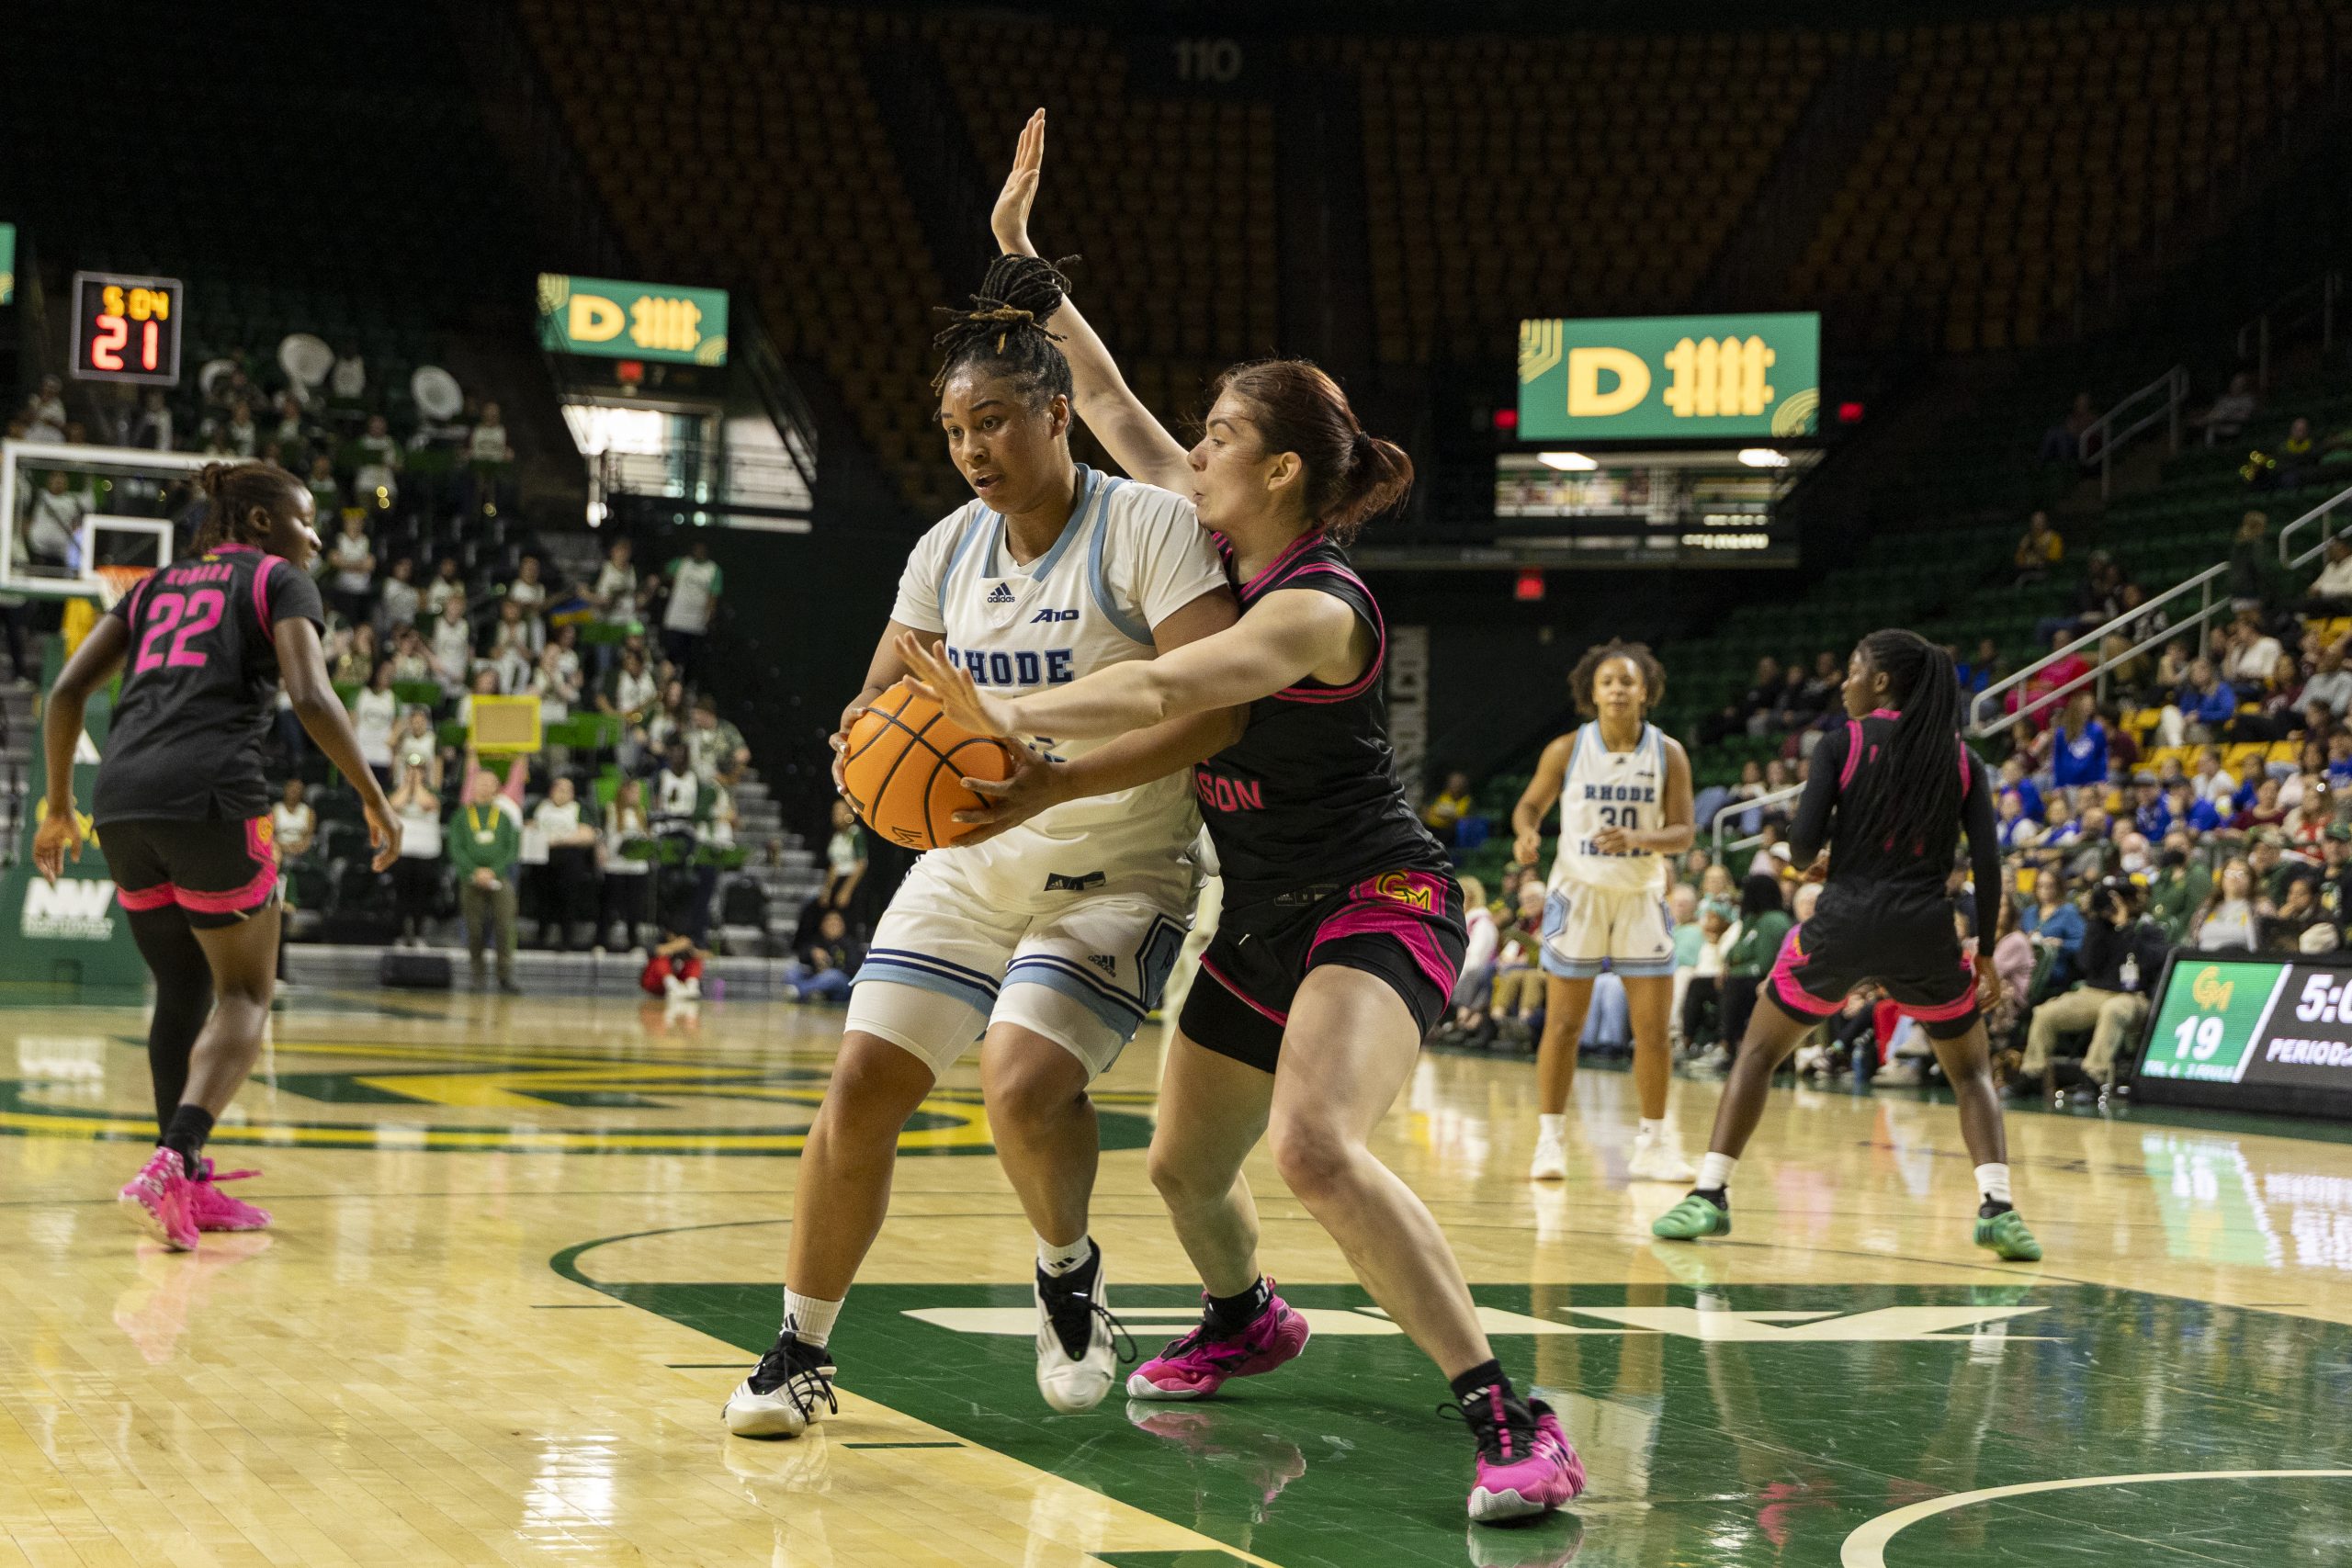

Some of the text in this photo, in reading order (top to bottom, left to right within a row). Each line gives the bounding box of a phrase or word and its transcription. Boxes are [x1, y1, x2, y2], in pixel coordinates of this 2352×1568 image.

[1174, 38, 1242, 82] 110
[569, 294, 626, 342] D
[92, 314, 158, 371] 21
[1567, 346, 1652, 417] D
[134, 589, 225, 674] 22
[1195, 773, 1264, 811] SON
[1585, 784, 1656, 803] RHODE
[2175, 1015, 2224, 1061] 19
